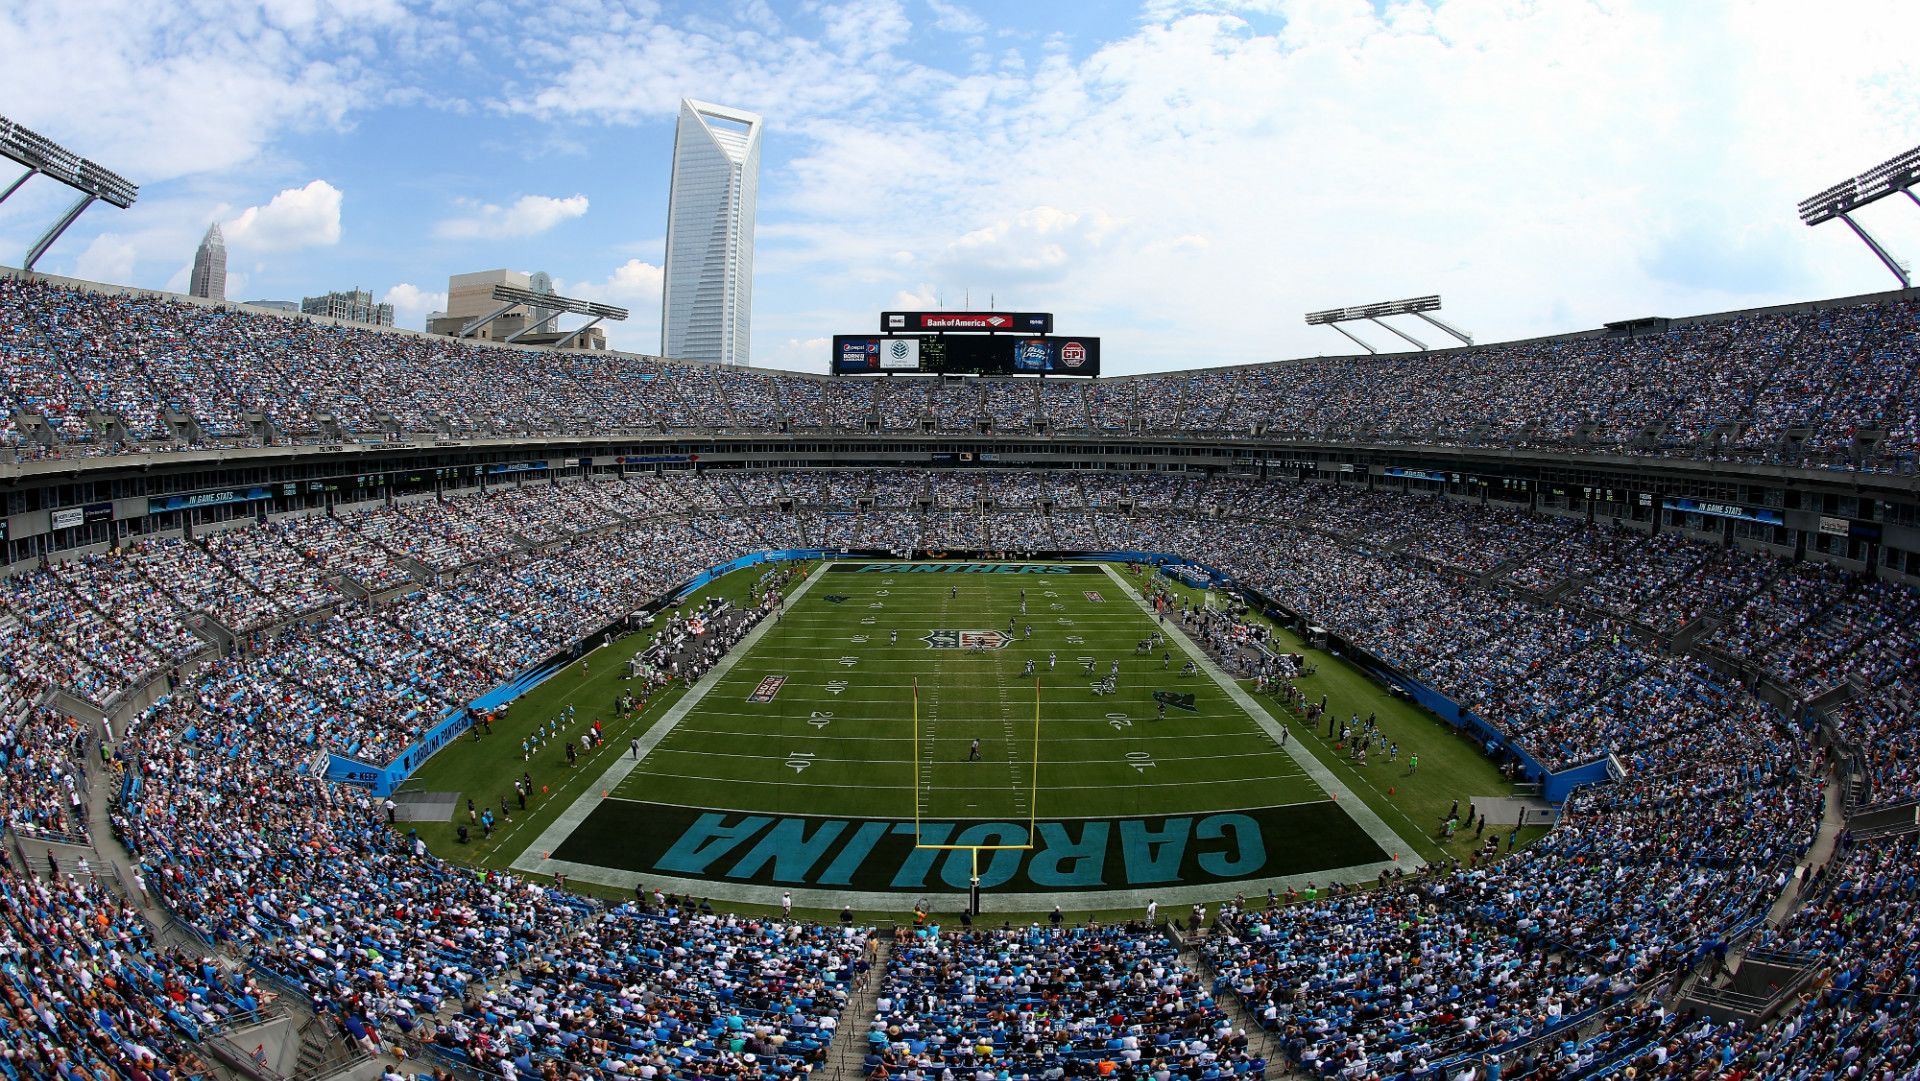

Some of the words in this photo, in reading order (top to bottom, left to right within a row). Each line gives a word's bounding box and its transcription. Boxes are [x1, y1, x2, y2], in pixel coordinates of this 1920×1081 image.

[927, 319, 946, 327] Bank
[946, 319, 954, 327] of
[954, 318, 986, 327] America
[1063, 351, 1084, 359] CPI
[189, 495, 197, 505] IN
[197, 493, 215, 504] GAME
[216, 491, 234, 502] STATS
[1698, 502, 1706, 511] IN
[1706, 503, 1724, 513] GAME
[1724, 505, 1743, 516] STATS
[856, 564, 1073, 574] PANTHERS
[807, 711, 834, 725] 20
[1105, 713, 1133, 727] 20
[413, 736, 440, 767] CAROLINA
[785, 751, 816, 768] 10
[1125, 751, 1157, 769] 10
[359, 772, 378, 781] KEEP
[652, 812, 1268, 888] CAROLINA
